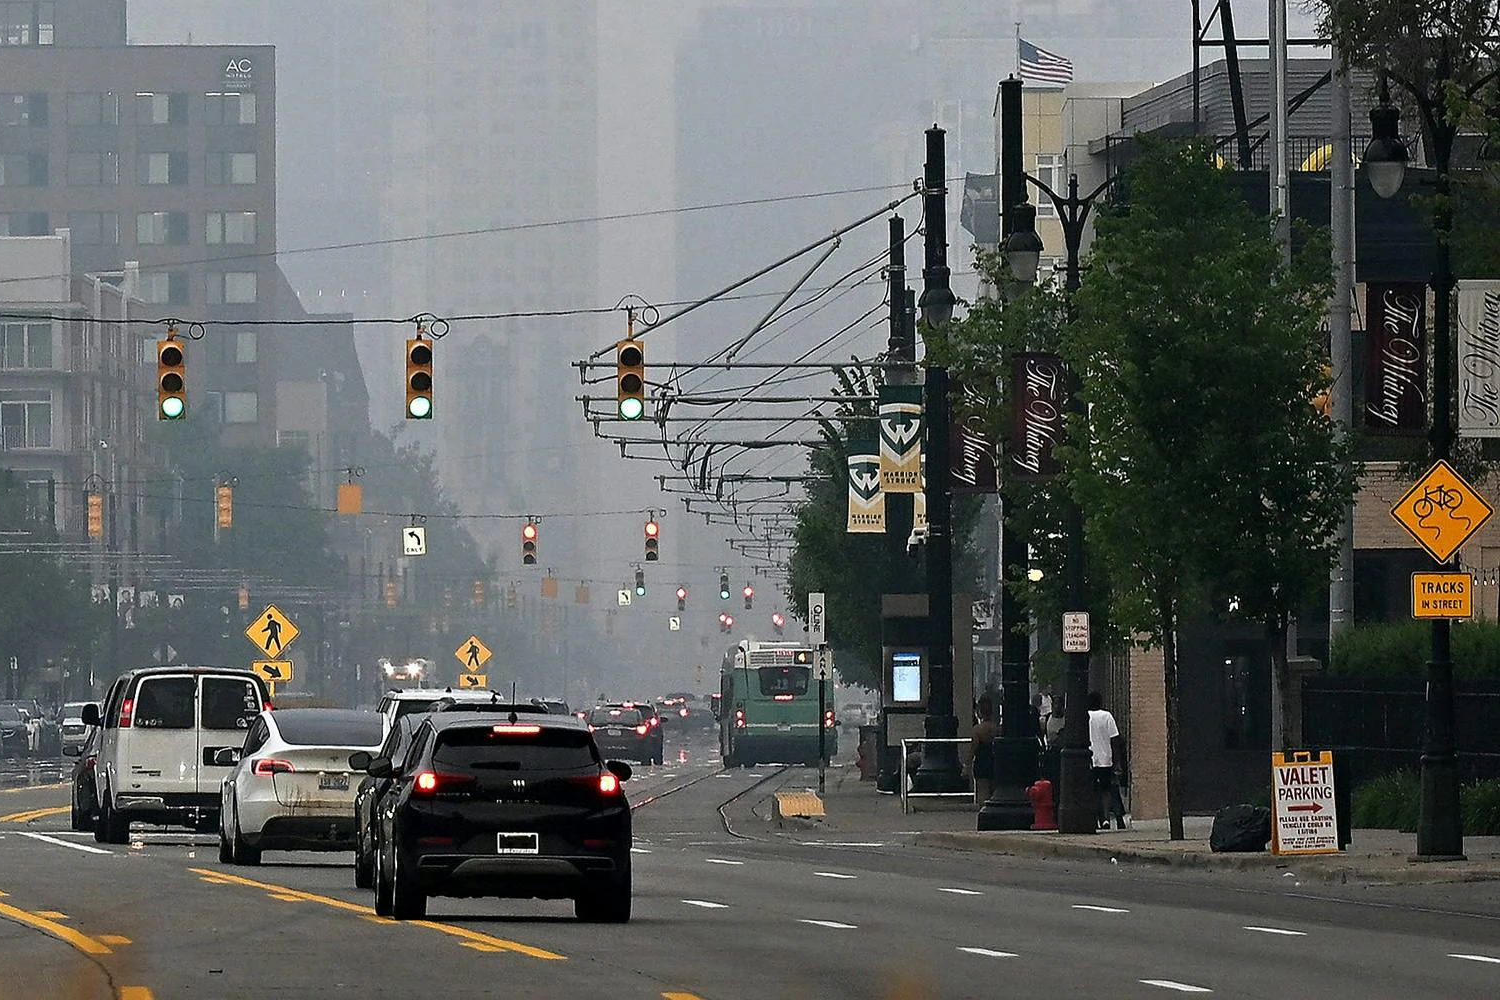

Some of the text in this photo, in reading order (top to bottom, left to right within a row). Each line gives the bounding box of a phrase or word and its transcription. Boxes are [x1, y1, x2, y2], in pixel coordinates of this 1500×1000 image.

[226, 59, 252, 73] AC
[1366, 289, 1425, 425] The Whitney
[1461, 379, 1499, 426] The
[1011, 360, 1058, 474] The Whitney
[1421, 582, 1464, 594] TRACKS
[1422, 599, 1463, 609] IN STREET
[1279, 766, 1328, 786] VALET
[1279, 786, 1332, 801] PARKING
